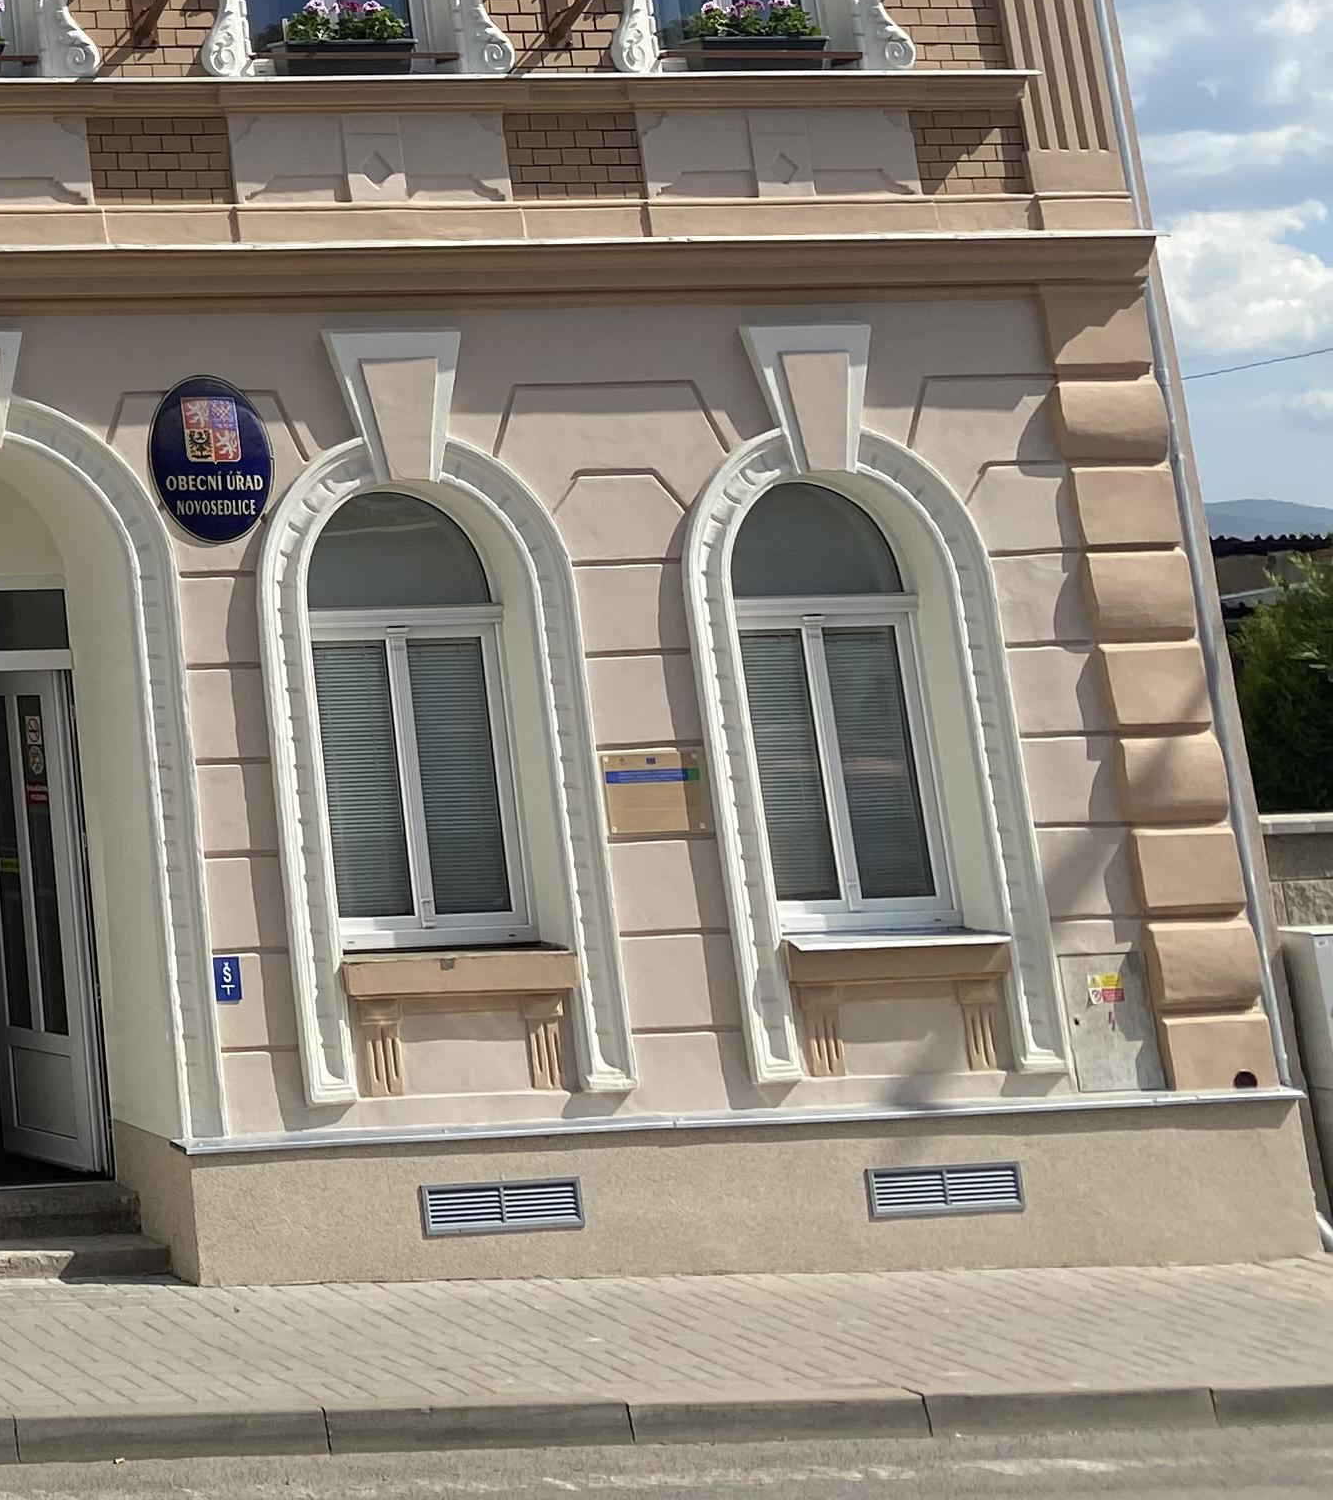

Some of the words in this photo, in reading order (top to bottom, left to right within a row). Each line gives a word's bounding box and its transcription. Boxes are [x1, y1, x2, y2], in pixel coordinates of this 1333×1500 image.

[165, 470, 223, 491] OBECNÍ
[226, 470, 264, 491] ÚŘAD
[176, 499, 256, 516] NOVOSEDLICE
[222, 961, 232, 983] Š
